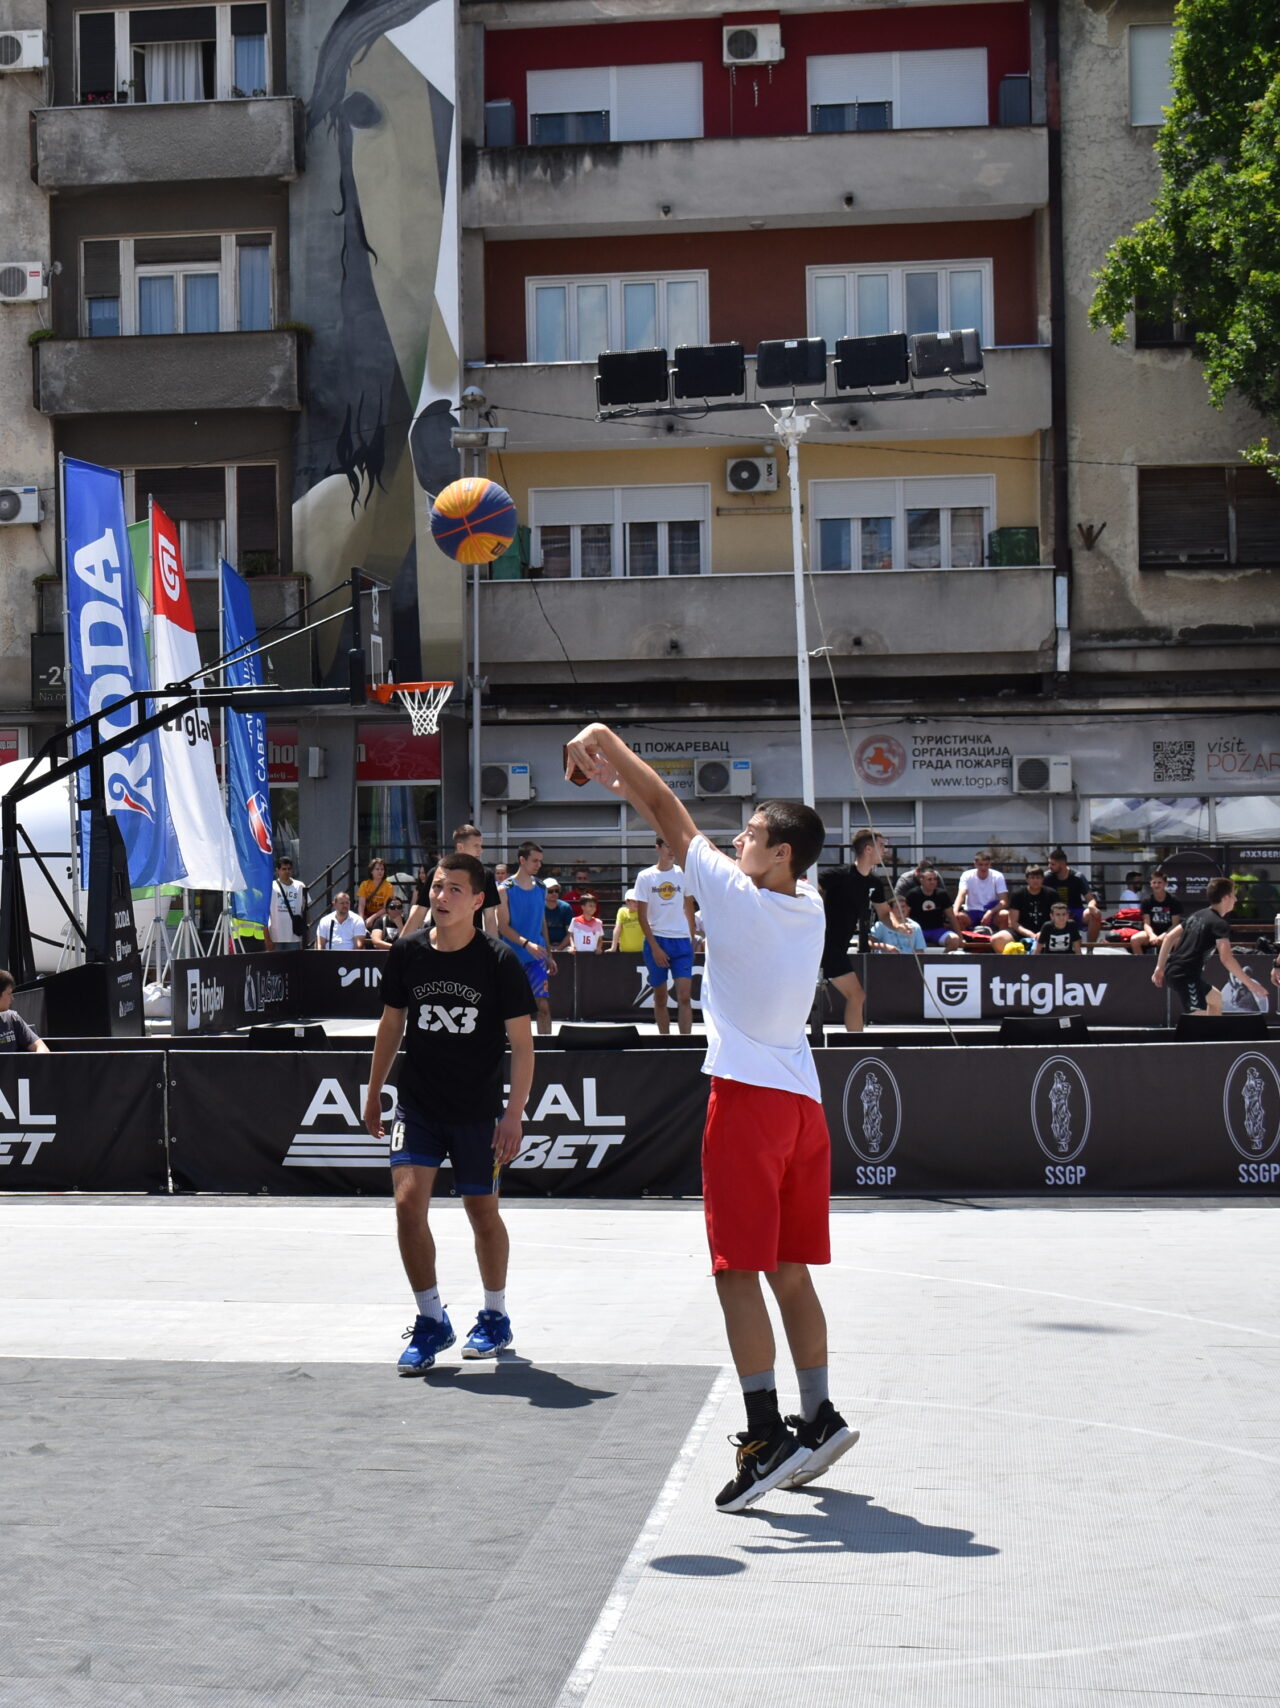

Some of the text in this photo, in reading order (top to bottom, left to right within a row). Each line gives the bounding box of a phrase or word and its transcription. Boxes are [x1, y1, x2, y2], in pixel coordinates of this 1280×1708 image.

[74, 527, 156, 824] RODA
[645, 741, 730, 753] ПОЖАРЕВАЦ
[911, 734, 992, 746] ТУРИСТИЧКА
[1207, 736, 1244, 754] visit
[911, 746, 1011, 760] ОРГАНИЗАЦИЈА
[912, 759, 952, 770] ГРАДА
[930, 775, 1009, 789] www.togp.rs
[201, 976, 225, 1021] triglav
[989, 973, 1108, 1015] triglav
[391, 1121, 406, 1152] 6
[508, 1134, 626, 1169] BET
[856, 1166, 897, 1186] SSGP
[1044, 1165, 1087, 1186] SSGP
[1238, 1163, 1280, 1184] SSGP
